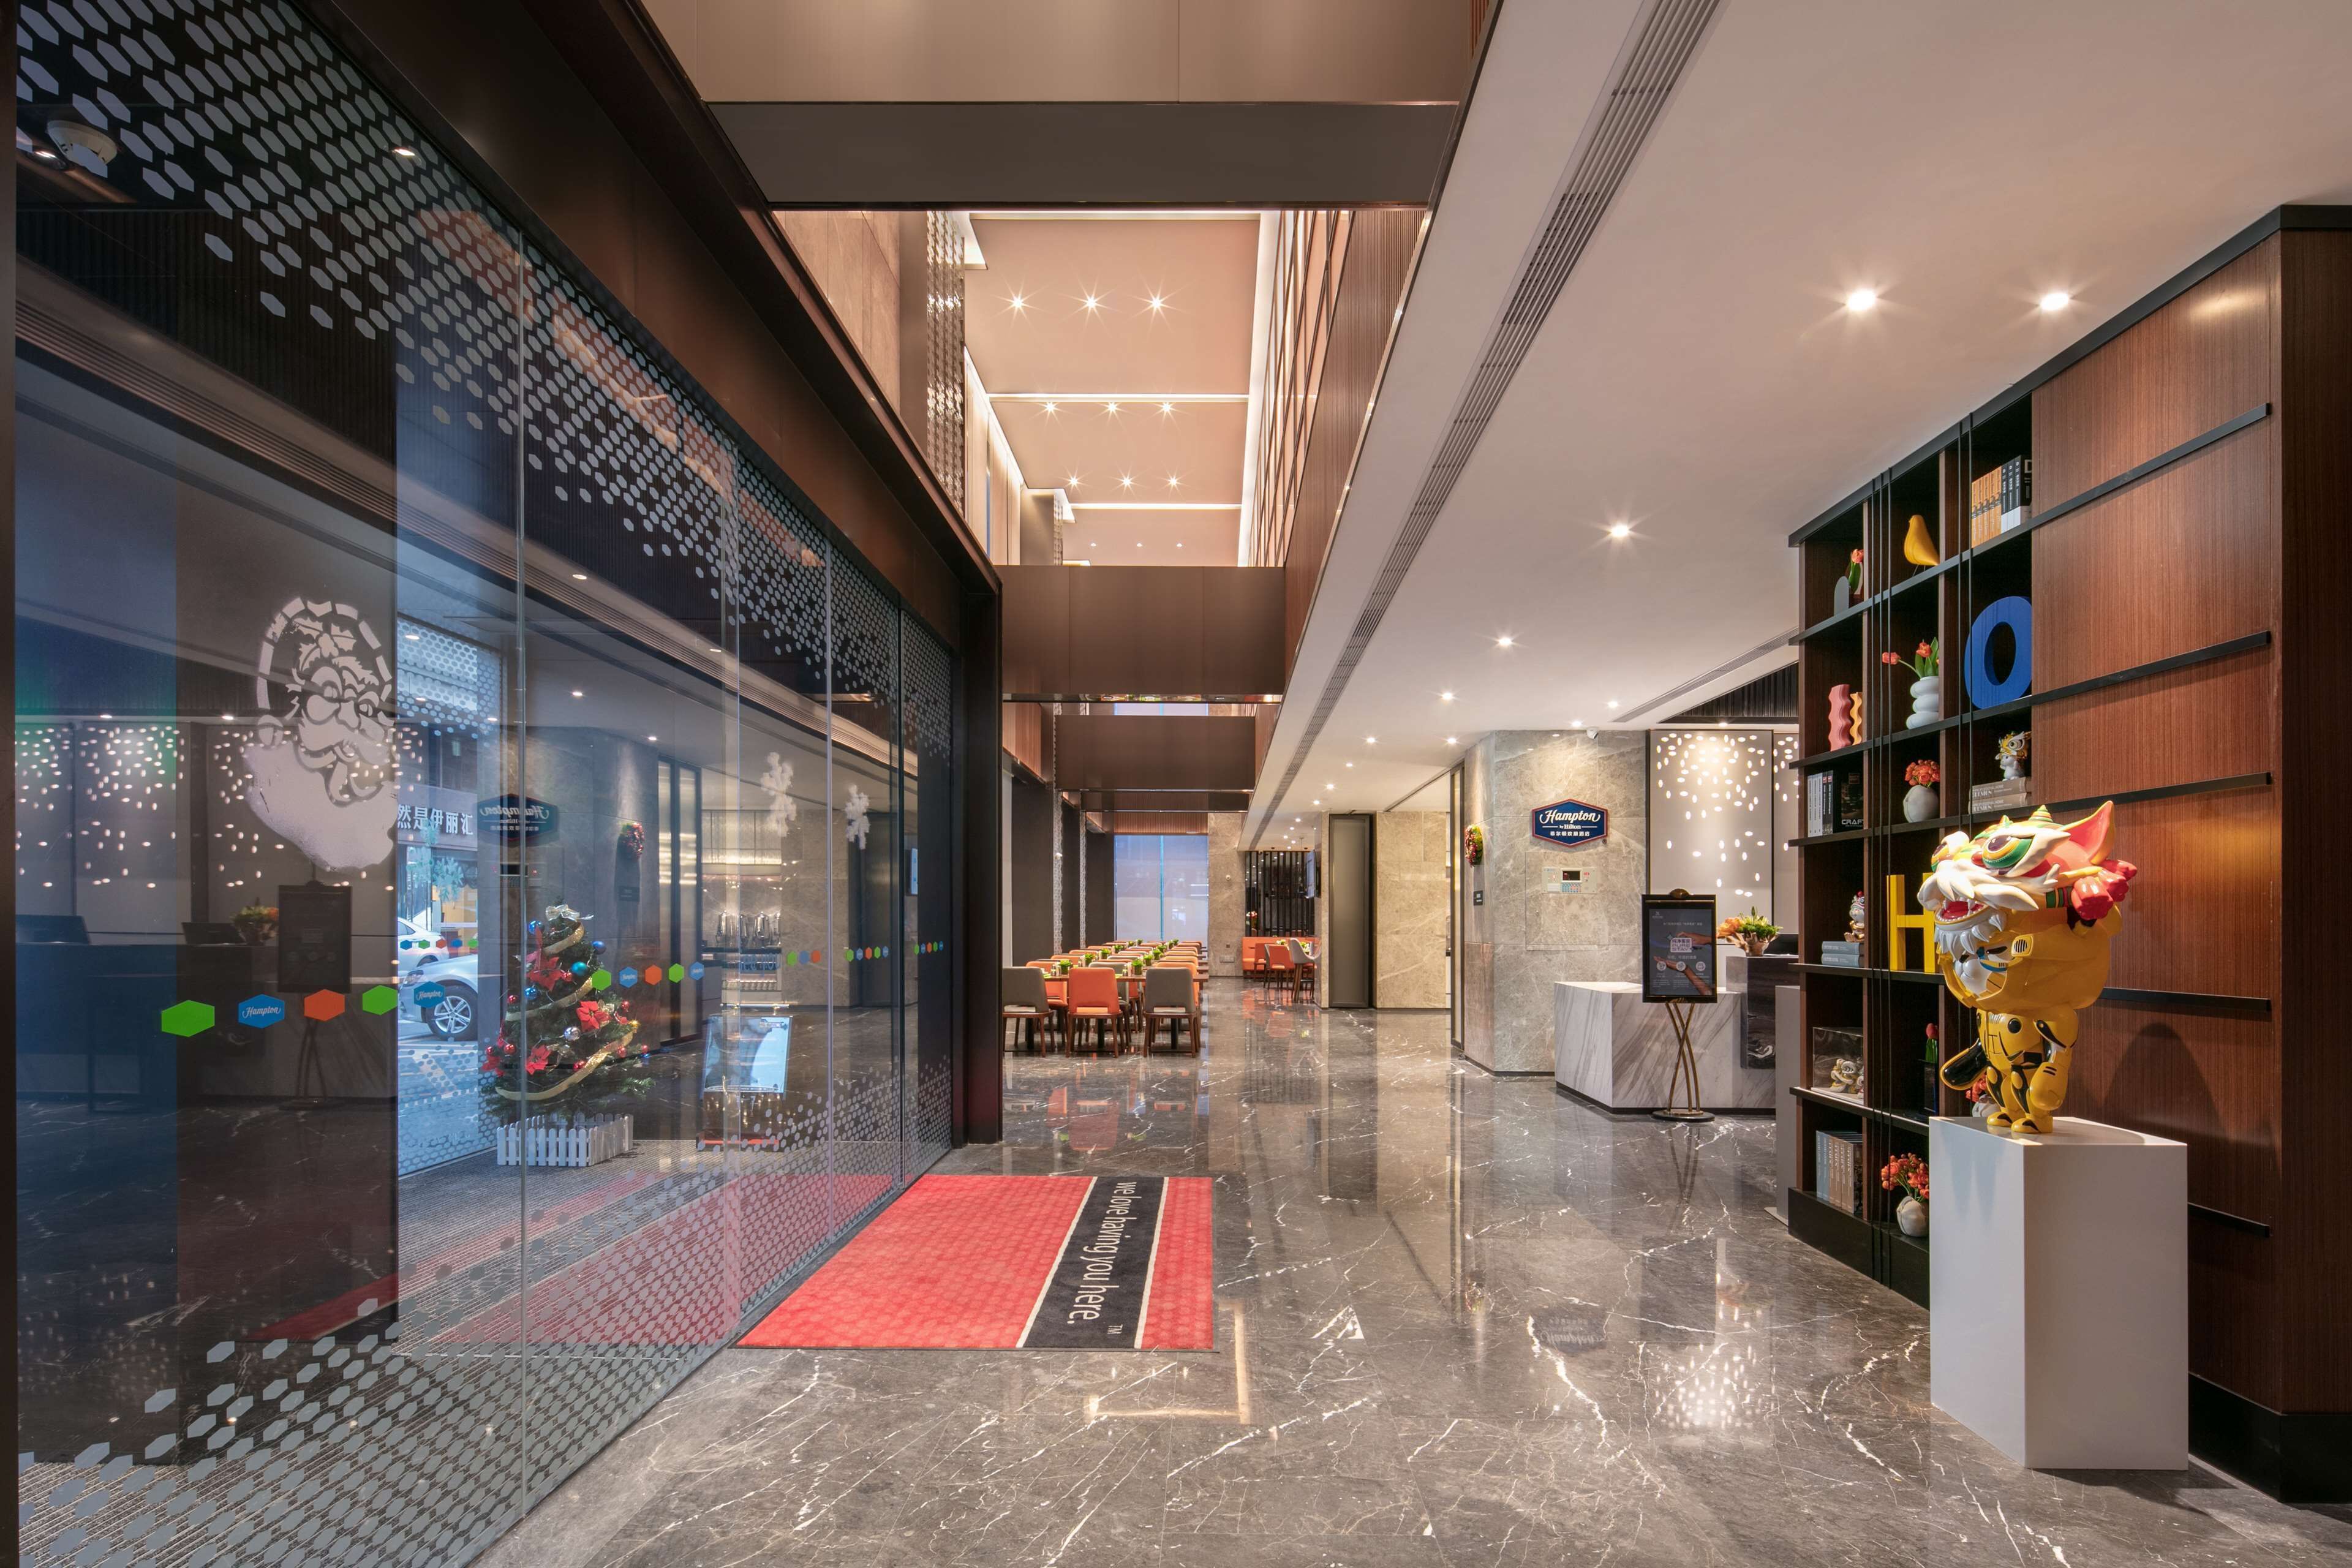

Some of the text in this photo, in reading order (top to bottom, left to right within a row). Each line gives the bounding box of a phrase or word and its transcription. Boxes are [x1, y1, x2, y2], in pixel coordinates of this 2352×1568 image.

[1539, 809, 1600, 824] Hampton
[416, 989, 443, 1000] Hampton
[242, 1006, 282, 1019] Hampton
[1114, 1182, 1137, 1194] we
[1106, 1196, 1142, 1215] love
[1083, 1217, 1137, 1254] having
[1080, 1256, 1114, 1281] you
[1066, 1285, 1120, 1324] here.
